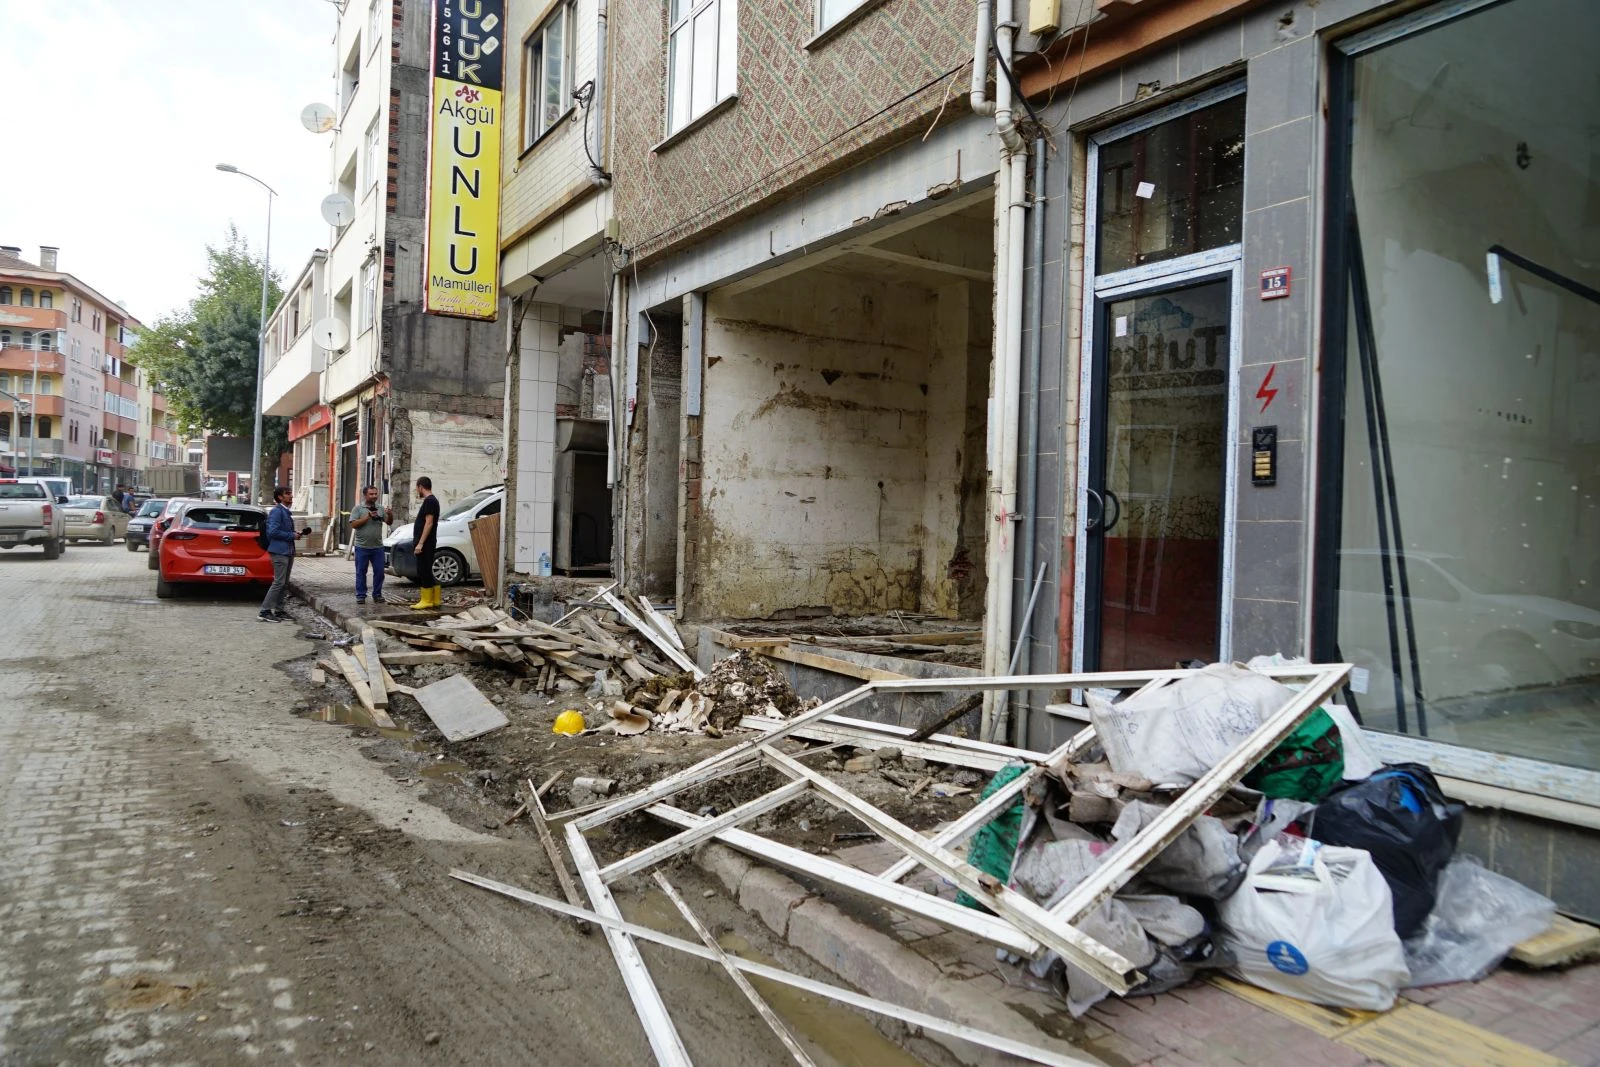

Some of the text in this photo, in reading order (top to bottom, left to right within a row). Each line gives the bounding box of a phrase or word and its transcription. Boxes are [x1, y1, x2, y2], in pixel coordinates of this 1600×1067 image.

[439, 97, 494, 125] Akgül
[450, 126, 481, 275] UNLU
[432, 275, 492, 294] Mamülleri
[1269, 276, 1281, 289] 15
